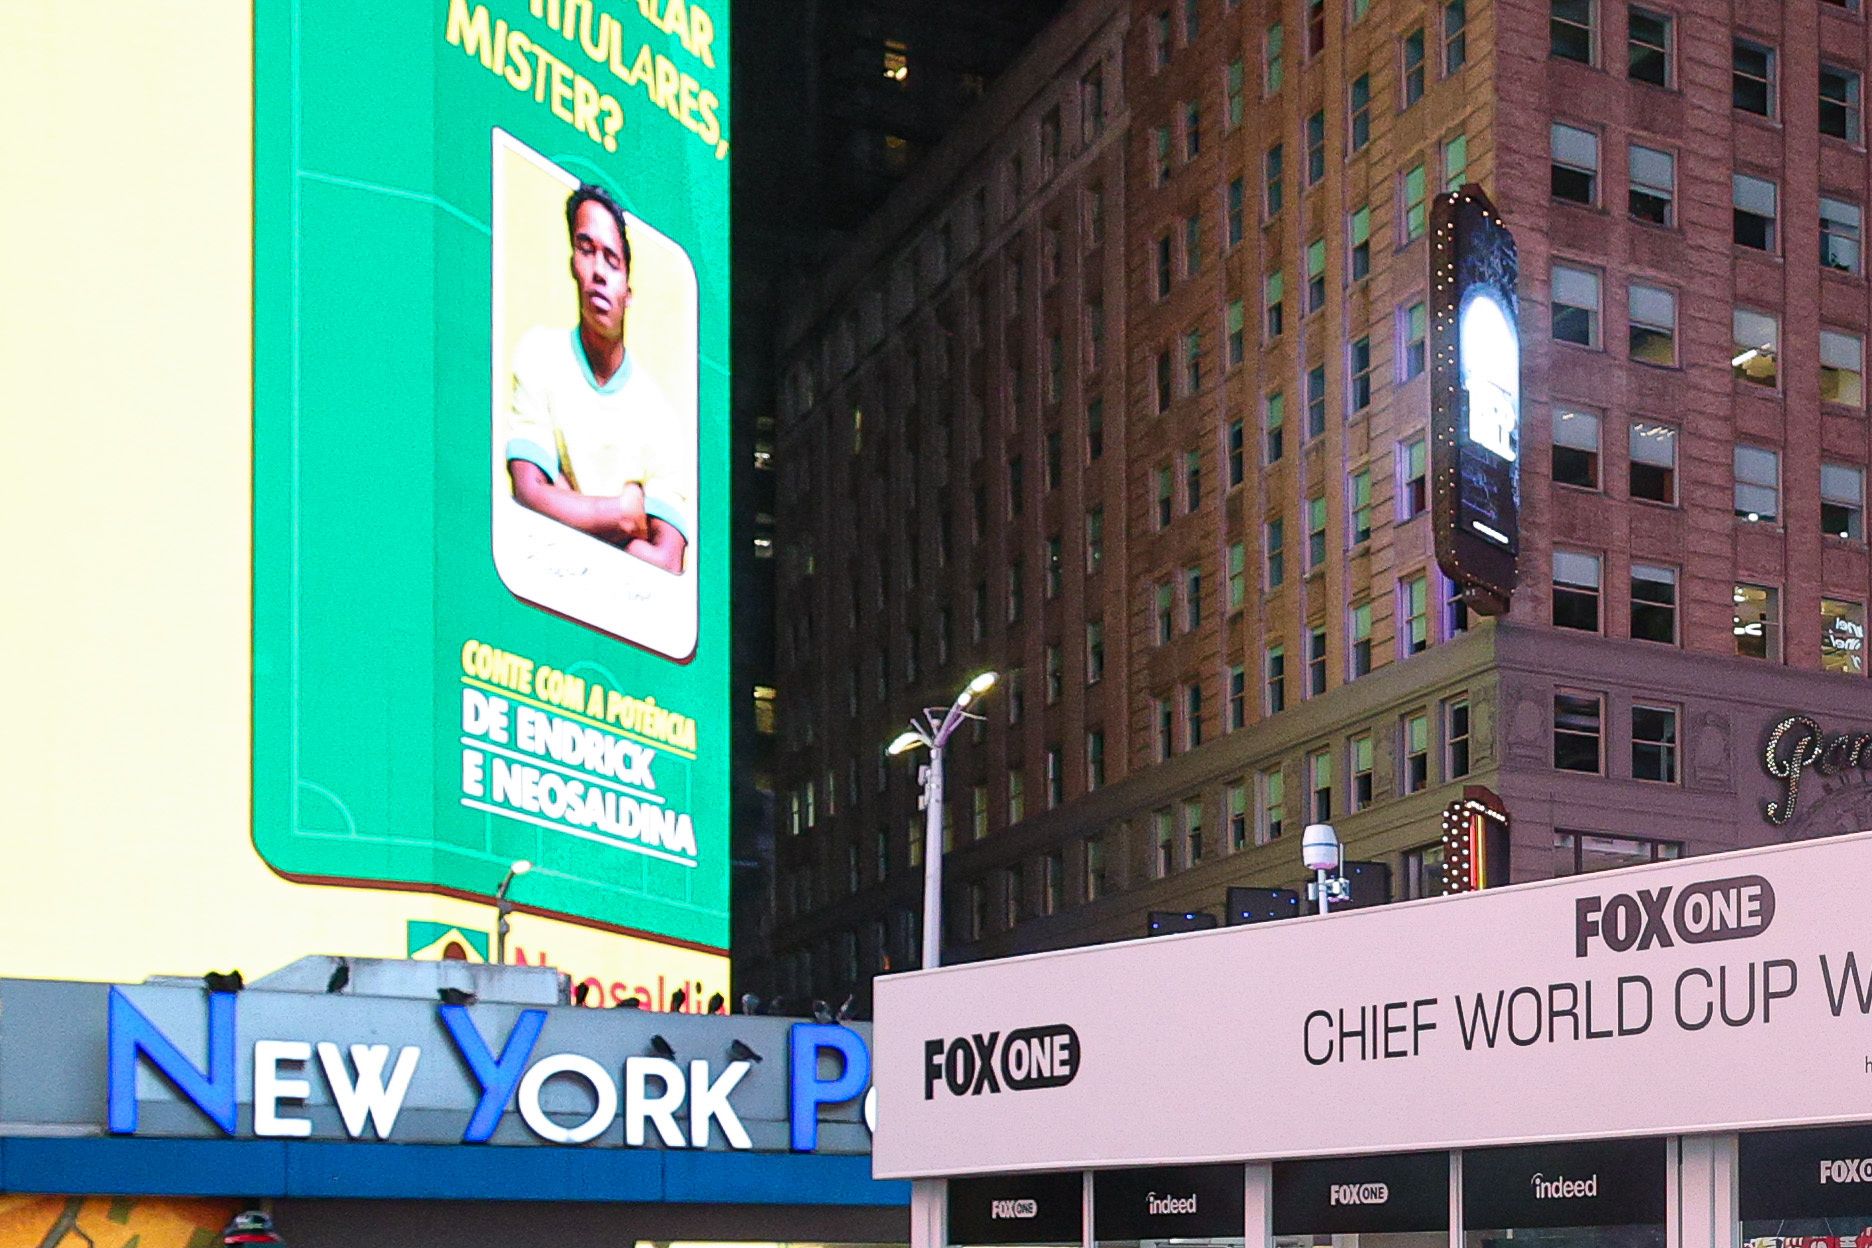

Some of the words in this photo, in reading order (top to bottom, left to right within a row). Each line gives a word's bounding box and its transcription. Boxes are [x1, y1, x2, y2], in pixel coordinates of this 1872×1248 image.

[446, 0, 624, 153] MISTER?
[461, 639, 535, 694] CONTE
[535, 665, 586, 713] COM
[586, 684, 605, 720] A
[606, 690, 697, 751] POTÊNCIA
[462, 688, 509, 744] DE
[516, 705, 656, 790] ENDRICK
[462, 749, 484, 797] E
[492, 757, 697, 856] NEOSALDINA
[1574, 886, 1675, 958] FOX
[1681, 882, 1766, 937] ONE
[1303, 998, 1438, 1066] CHIEF
[1454, 975, 1653, 1051] WORLD
[1674, 958, 1798, 1031] CUP
[107, 983, 420, 1139] NEW
[439, 1004, 754, 1150] YORK
[790, 1022, 877, 1152] P
[924, 1031, 1001, 1100] FOX
[1006, 1030, 1074, 1084] ONE
[991, 1200, 1015, 1219] FOX
[1016, 1201, 1036, 1216] ONE
[1147, 1192, 1197, 1215] indeed
[1330, 1184, 1360, 1206] FOX
[1361, 1185, 1386, 1201] ONE
[1532, 1173, 1598, 1200] indeed
[1819, 1159, 1859, 1184] FOX
